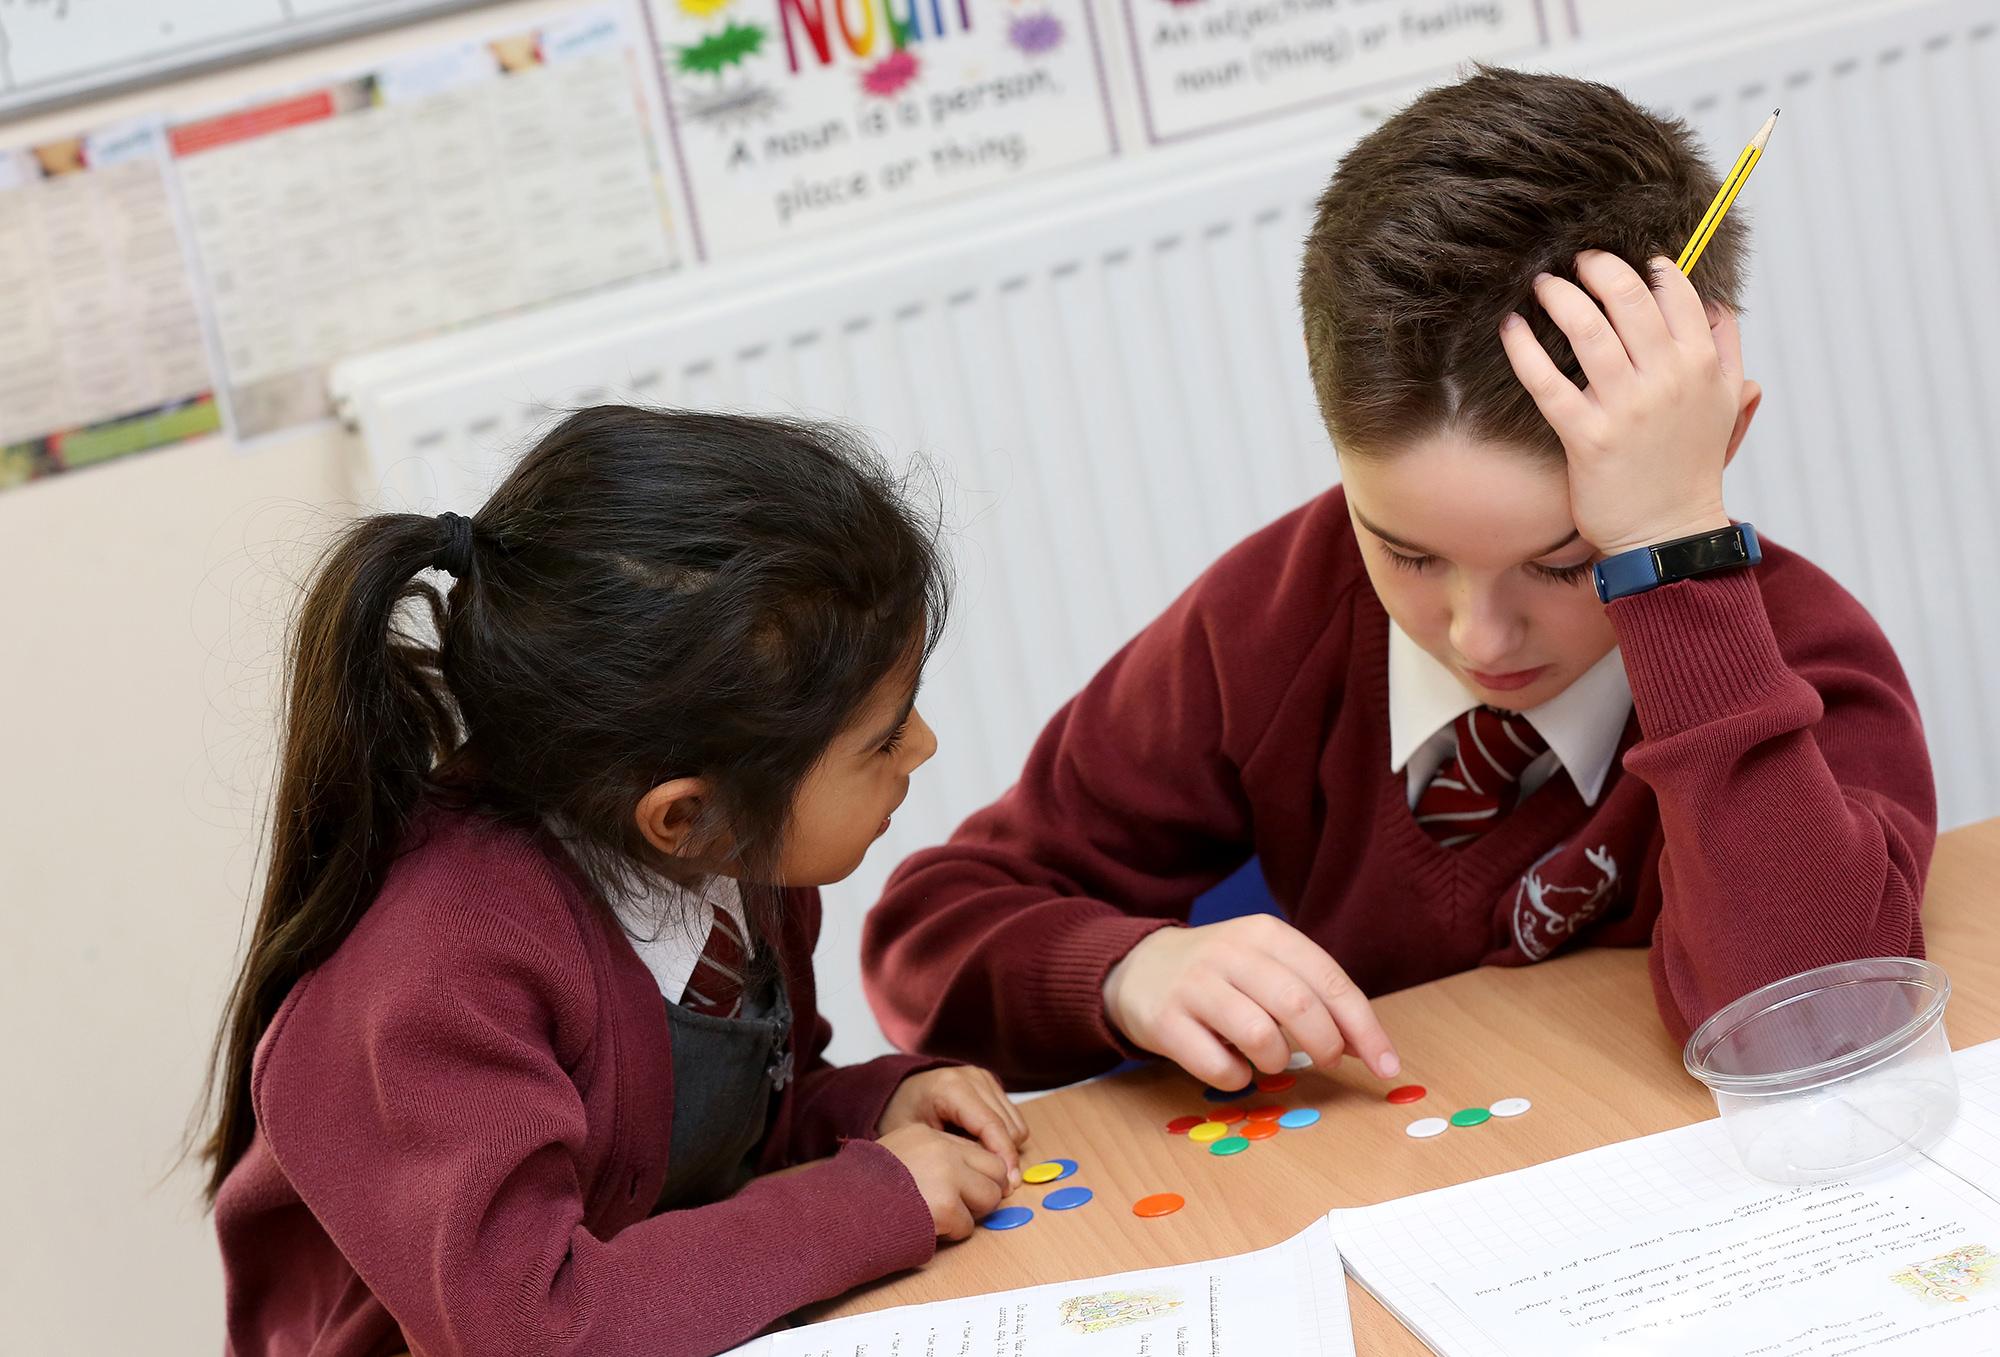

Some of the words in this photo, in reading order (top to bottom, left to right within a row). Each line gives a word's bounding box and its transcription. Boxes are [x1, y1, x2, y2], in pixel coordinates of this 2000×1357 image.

[1175, 60, 1243, 93] noun
[1360, 24, 1390, 49] or
[727, 139, 754, 170] A
[763, 120, 847, 158] noun
[860, 104, 888, 135] is
[899, 102, 921, 126] a
[773, 172, 868, 227] place
[879, 157, 921, 190] or
